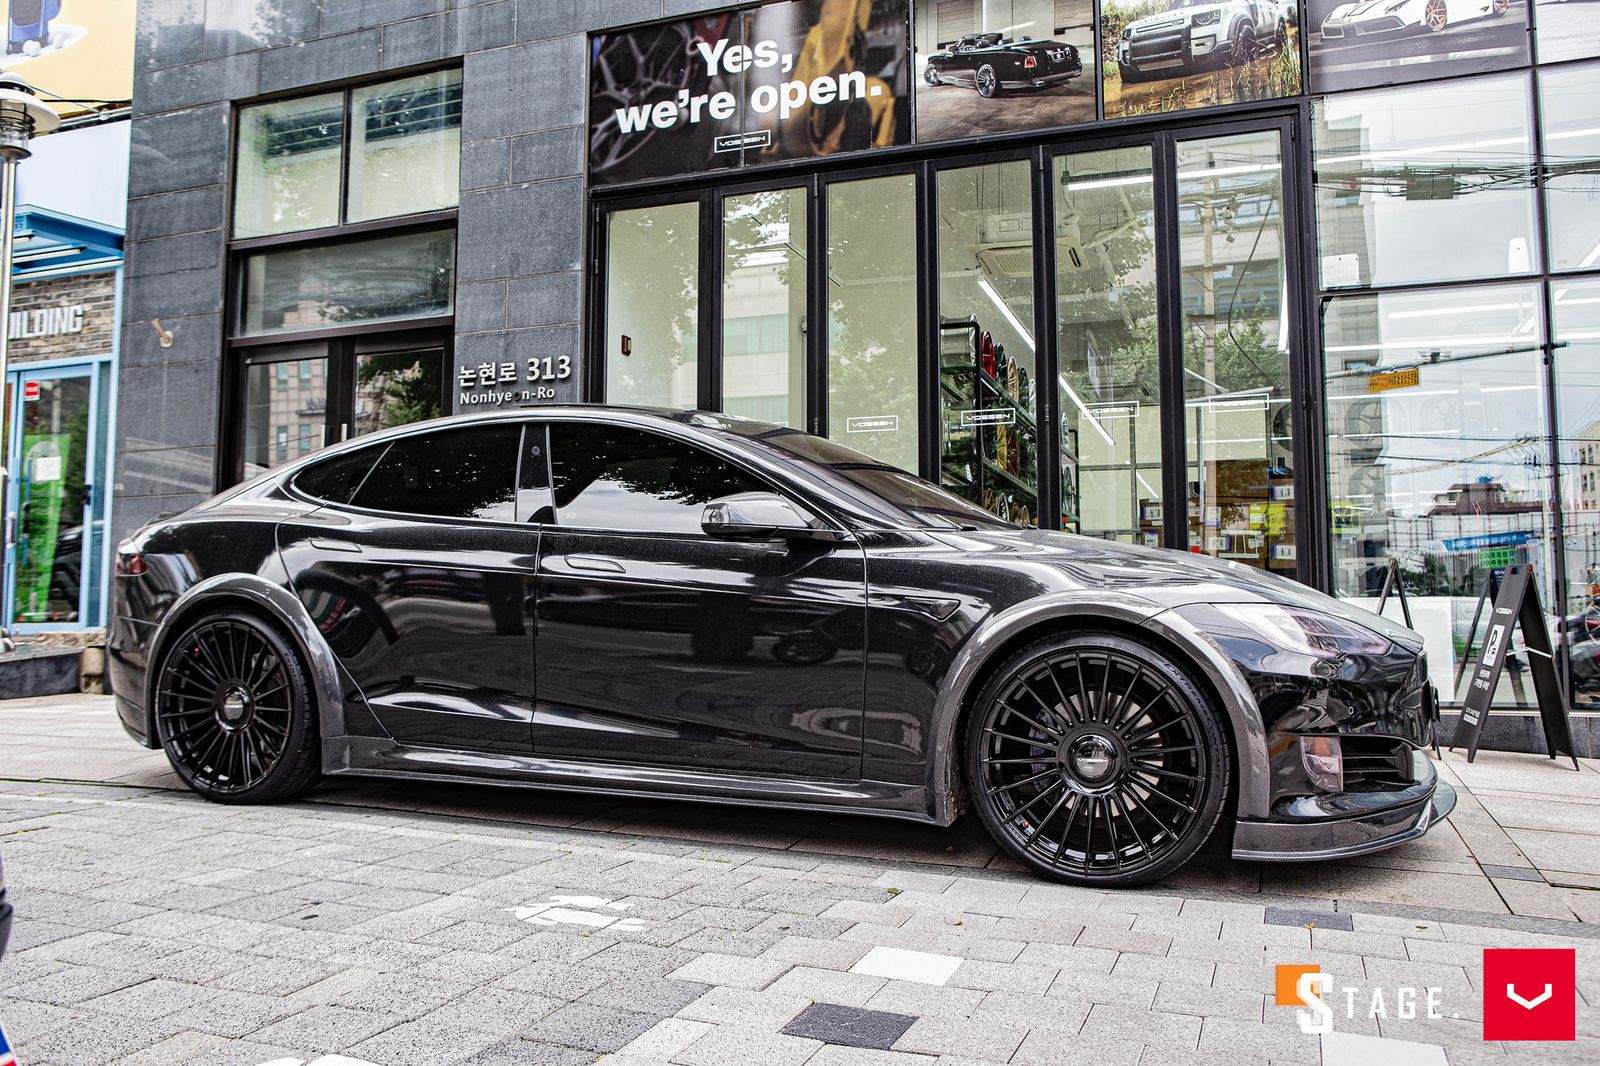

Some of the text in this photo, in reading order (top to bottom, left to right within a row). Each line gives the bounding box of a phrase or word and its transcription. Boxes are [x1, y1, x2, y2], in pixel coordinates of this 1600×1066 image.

[697, 38, 793, 77] Yes,
[615, 69, 882, 134] we're open.
[719, 135, 766, 147] VOSSEN
[457, 354, 571, 387] 논현로 313
[851, 419, 894, 428] VOSSEN
[965, 412, 1011, 422] VOSSEN
